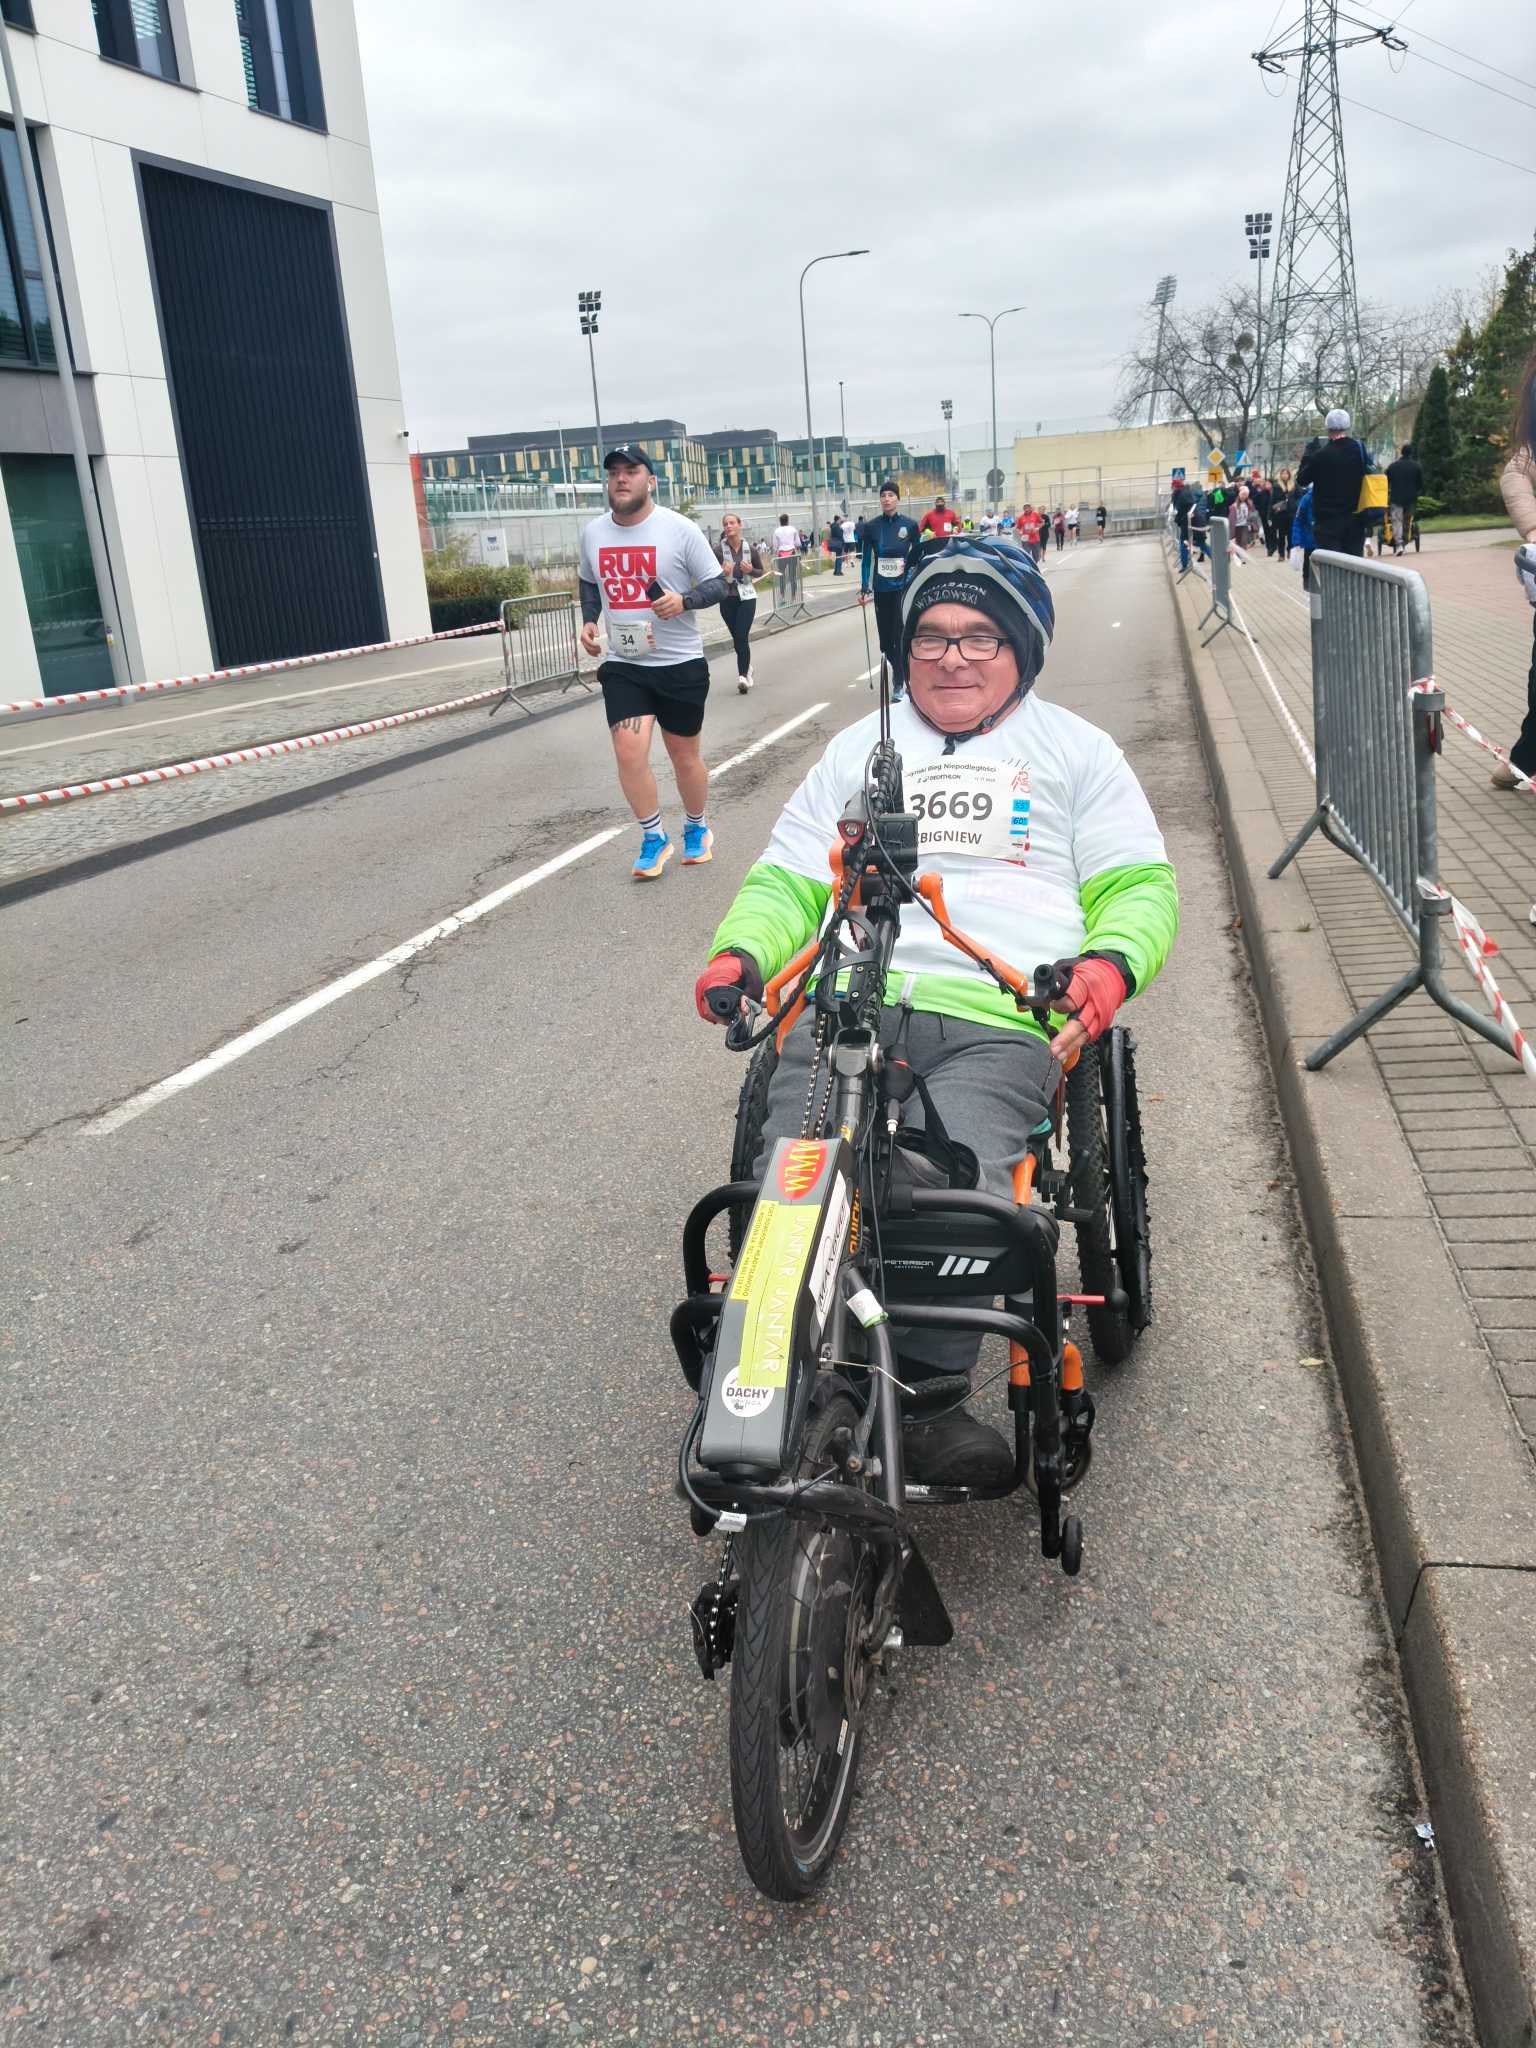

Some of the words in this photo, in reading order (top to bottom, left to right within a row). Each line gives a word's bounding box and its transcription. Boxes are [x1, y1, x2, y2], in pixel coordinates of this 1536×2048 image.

[599, 552, 657, 578] RUN
[603, 576, 657, 602] GDY
[620, 634, 635, 646] 34
[909, 790, 993, 822] 3669
[917, 830, 983, 844] BIGNIEW
[779, 1215, 808, 1277] JANTAR
[762, 1286, 790, 1373] JANTAR
[726, 1386, 769, 1399] DACHY
